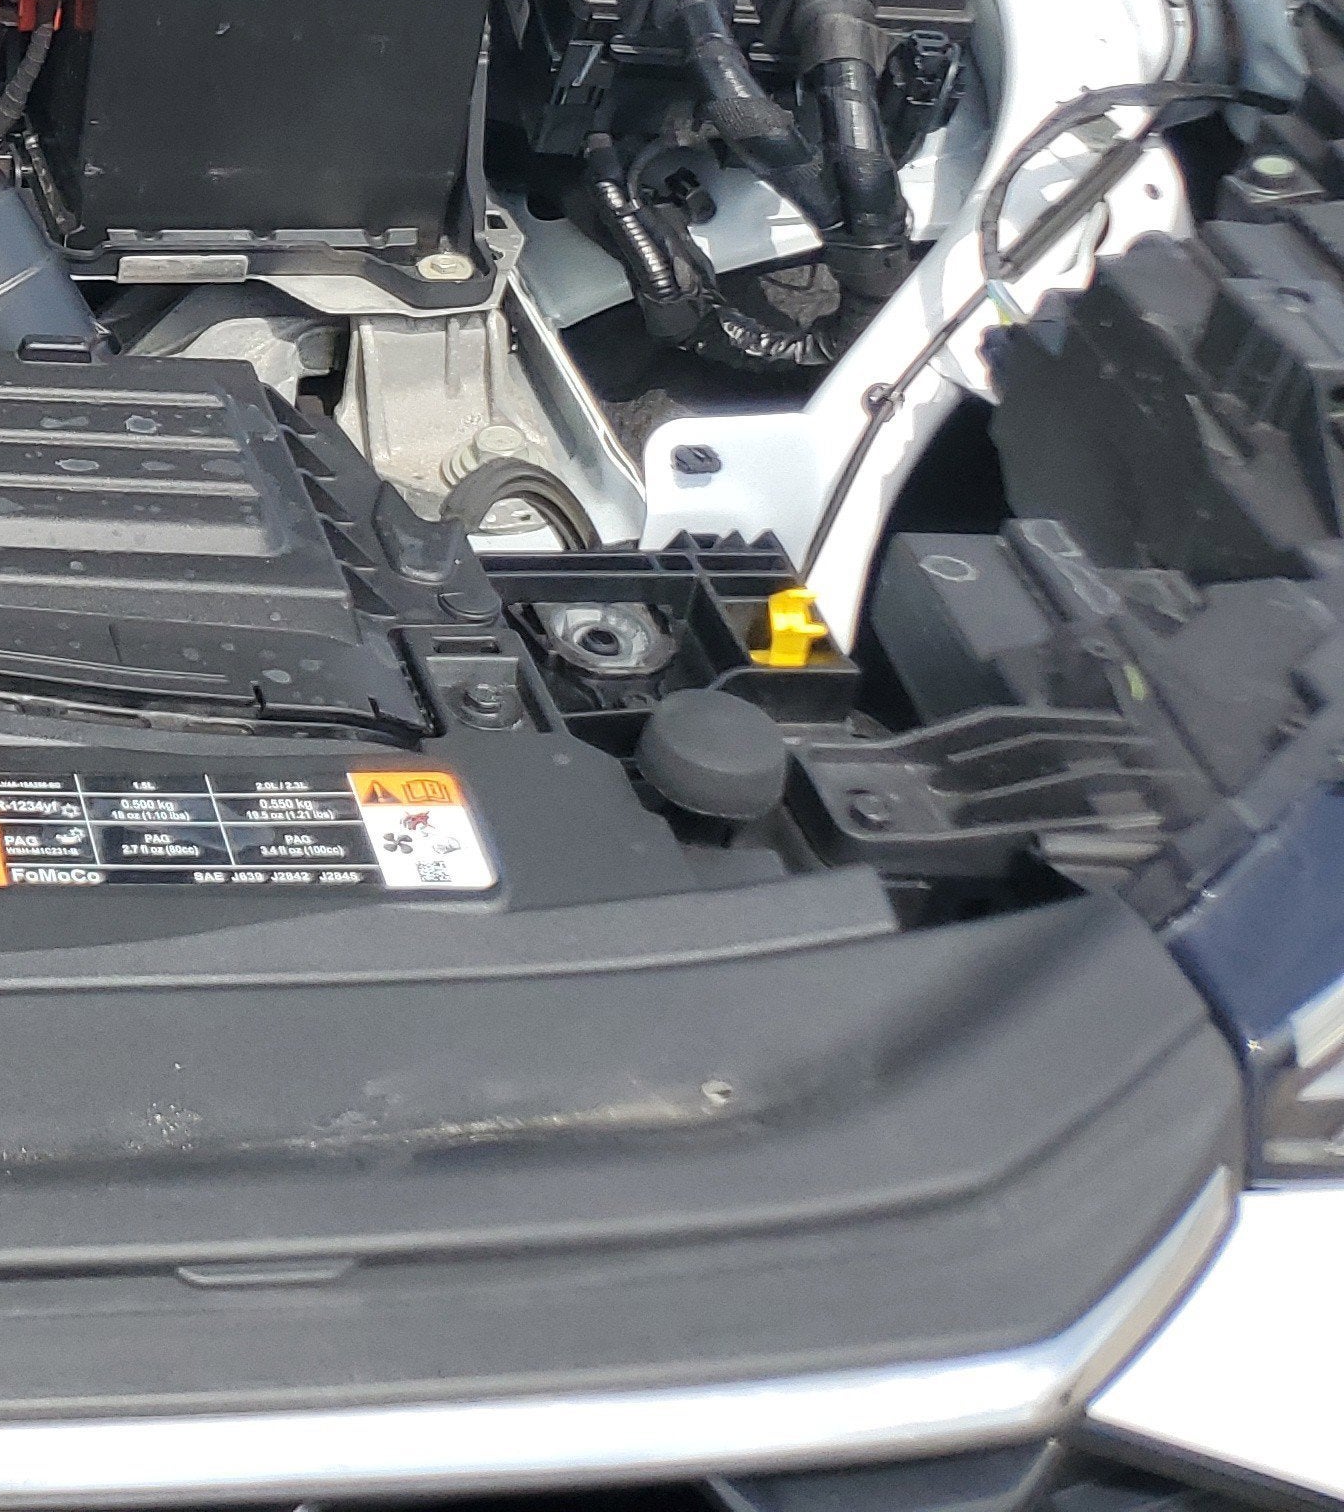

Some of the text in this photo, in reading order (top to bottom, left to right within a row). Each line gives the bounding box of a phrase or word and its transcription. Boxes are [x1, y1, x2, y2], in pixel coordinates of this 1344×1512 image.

[133, 781, 156, 790] 1.5L
[255, 781, 279, 790] 2.0L
[120, 798, 174, 812] 0.500 kg
[259, 798, 312, 811] 0.550 kg
[112, 811, 190, 821] 18 oz (1.10 lbs)
[271, 812, 284, 820] oz
[286, 811, 311, 820] (1.21
[313, 811, 334, 820] lbs)
[4, 835, 40, 847] PAG
[144, 834, 171, 844] PAG
[284, 834, 312, 845] PAG
[122, 845, 138, 856] 2.7
[140, 844, 149, 856] fl
[150, 846, 163, 856] oz
[260, 846, 344, 858] 3.4 fl oz (100cc)
[12, 868, 101, 883] FoMoCo
[193, 871, 359, 883] SAE J639 J2842 J2845
